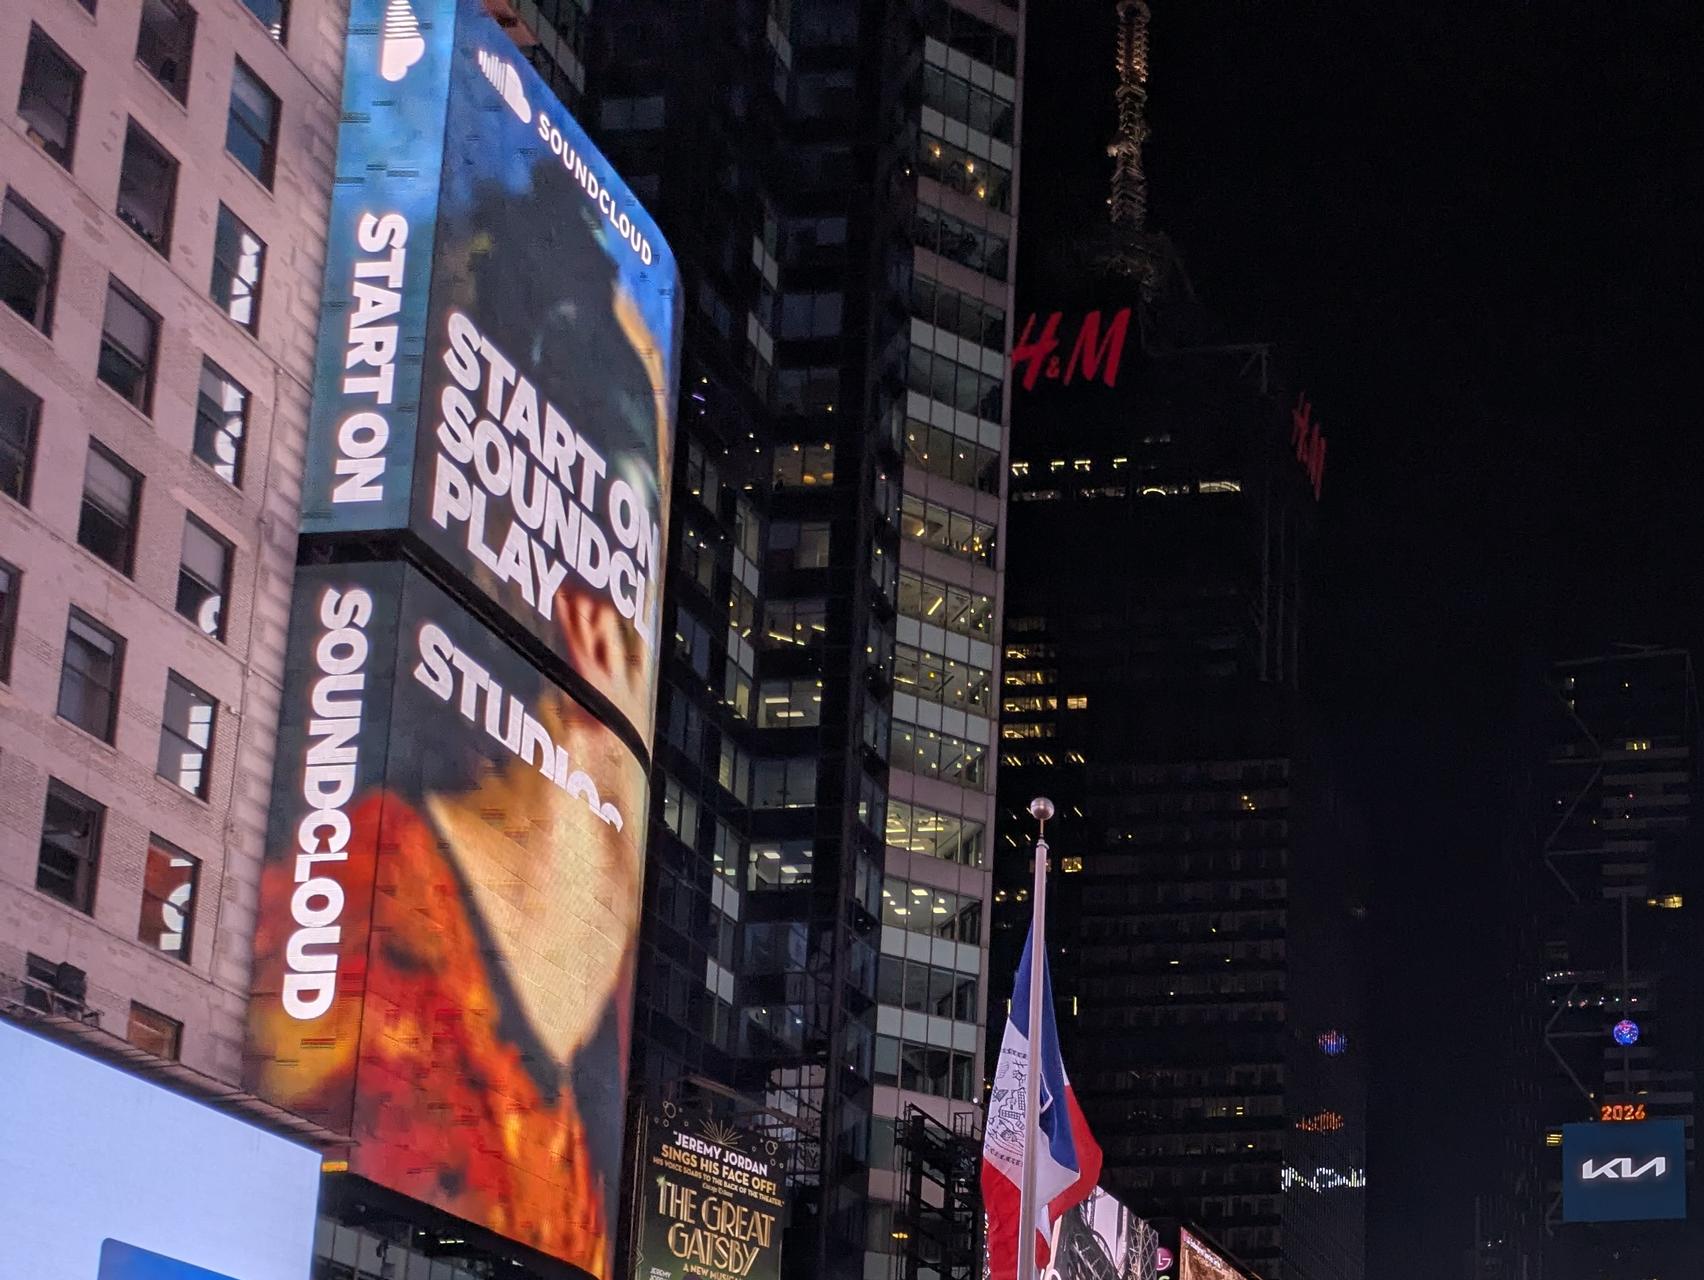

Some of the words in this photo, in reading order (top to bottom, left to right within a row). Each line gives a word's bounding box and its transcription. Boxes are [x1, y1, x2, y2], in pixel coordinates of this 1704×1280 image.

[536, 113, 654, 267] SOUNDCLOUD
[342, 212, 409, 405] START
[1011, 307, 1131, 391] H&M
[332, 411, 389, 503] ON
[441, 312, 606, 495] START
[609, 479, 658, 573] ON
[431, 456, 568, 623] PLAY
[435, 384, 652, 633] SOUNDCL
[281, 587, 373, 1020] SOUNDCLOUD
[1601, 1104, 1647, 1121] 2026
[661, 1144, 698, 1167] SINGS
[700, 1156, 719, 1175] HIS
[722, 1165, 749, 1187] FACE
[751, 1177, 777, 1196] OFF!
[723, 1152, 768, 1177] JORDAN
[724, 1179, 738, 1191] BACK
[739, 1185, 746, 1195] OF
[1582, 1156, 1666, 1180] KIA
[657, 1181, 698, 1224] THE
[701, 1196, 775, 1248] GREAT
[667, 1222, 760, 1276] GATSBY
[682, 1264, 689, 1272] A
[690, 1266, 709, 1280] NEW
